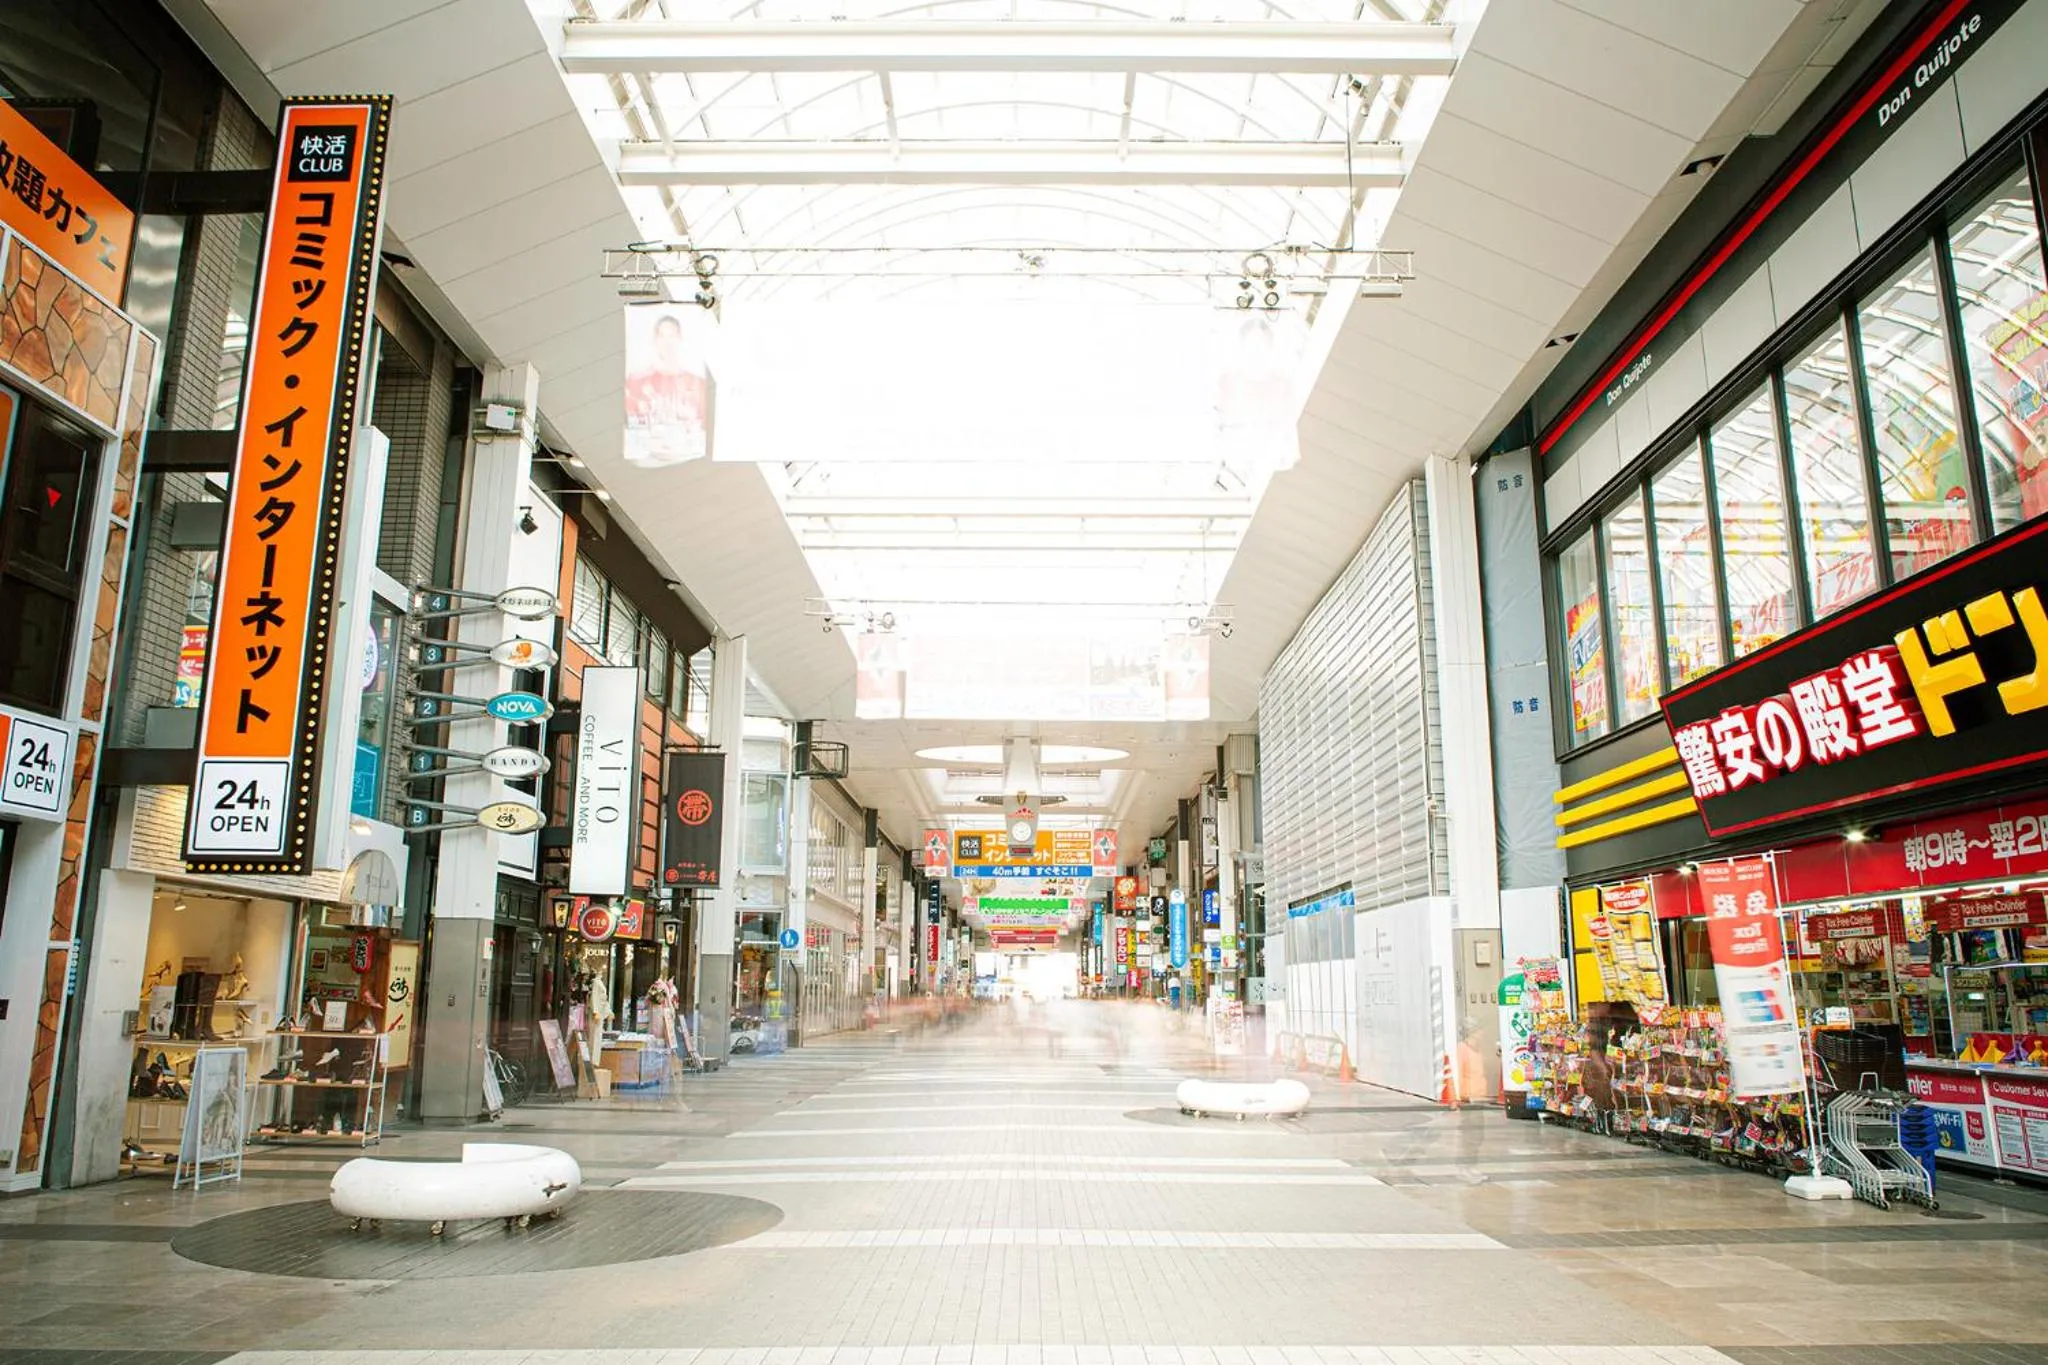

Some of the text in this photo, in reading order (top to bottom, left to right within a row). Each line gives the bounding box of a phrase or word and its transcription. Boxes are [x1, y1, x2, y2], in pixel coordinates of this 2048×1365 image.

[1878, 12, 1983, 128] Don Quijote
[300, 134, 348, 156] 快活
[298, 156, 344, 174] CLUB
[1605, 351, 1653, 407] Don Quijote
[235, 190, 336, 734] コミック・インターネット
[432, 596, 440, 608] 4
[427, 648, 436, 662] 3
[1674, 585, 2048, 800] 驚安の殿堂 ドン
[422, 701, 431, 715] 2
[496, 700, 538, 714] NOVA
[582, 714, 596, 761] COFFEE
[18, 738, 57, 774] 24h
[14, 771, 55, 795] OPEN
[214, 779, 271, 811] 24h
[580, 776, 591, 808] AND
[209, 815, 269, 833] OPEN
[413, 811, 422, 824] B
[576, 808, 588, 845] MORE
[1975, 902, 1993, 914] Free
